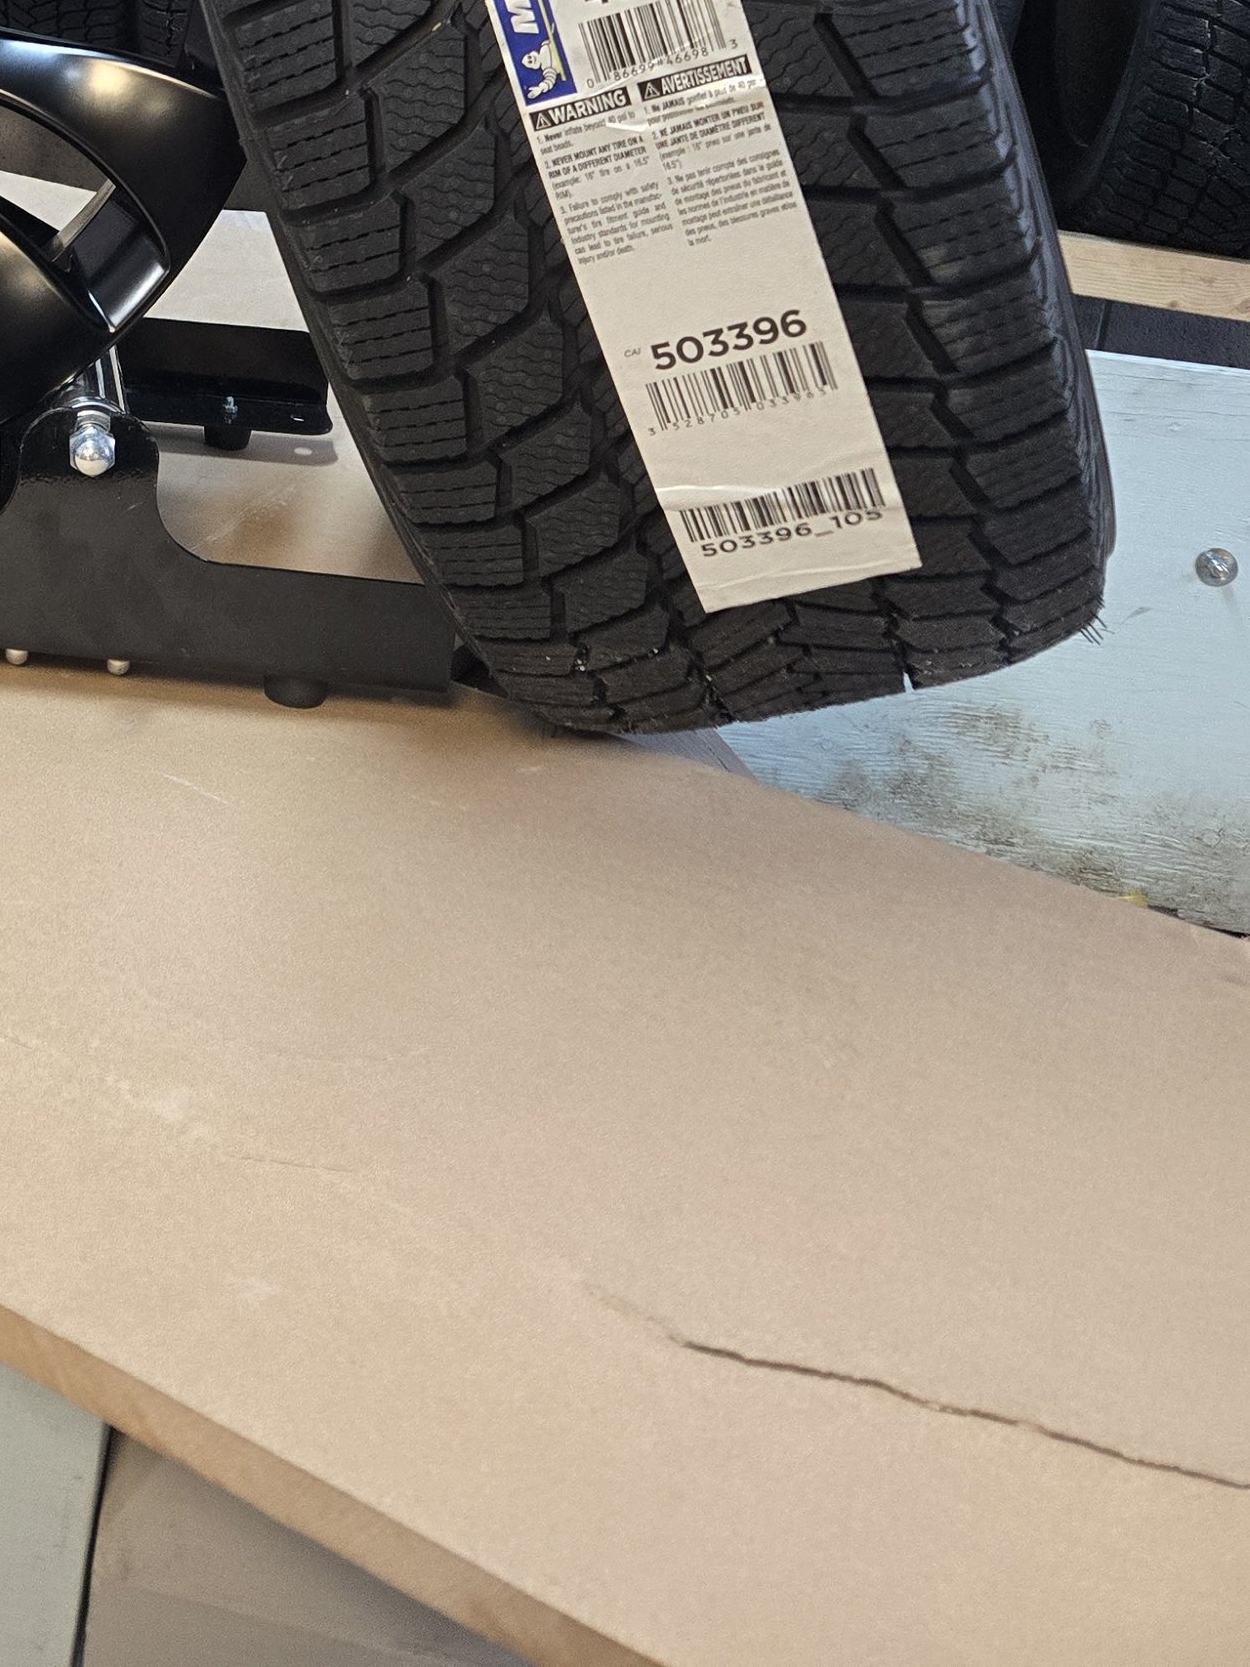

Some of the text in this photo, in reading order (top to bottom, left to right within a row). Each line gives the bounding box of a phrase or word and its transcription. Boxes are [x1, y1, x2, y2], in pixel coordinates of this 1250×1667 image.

[661, 57, 748, 95] AVERTISSEMENT
[548, 89, 626, 125] WARNING
[693, 113, 720, 128] MONTER
[543, 130, 563, 142] Never
[551, 134, 643, 166] NEVER MOUNT ANY TIRE ON A
[547, 145, 646, 179] RIM OF A DIFFERENT DIAMETER
[651, 310, 807, 370] 503396
